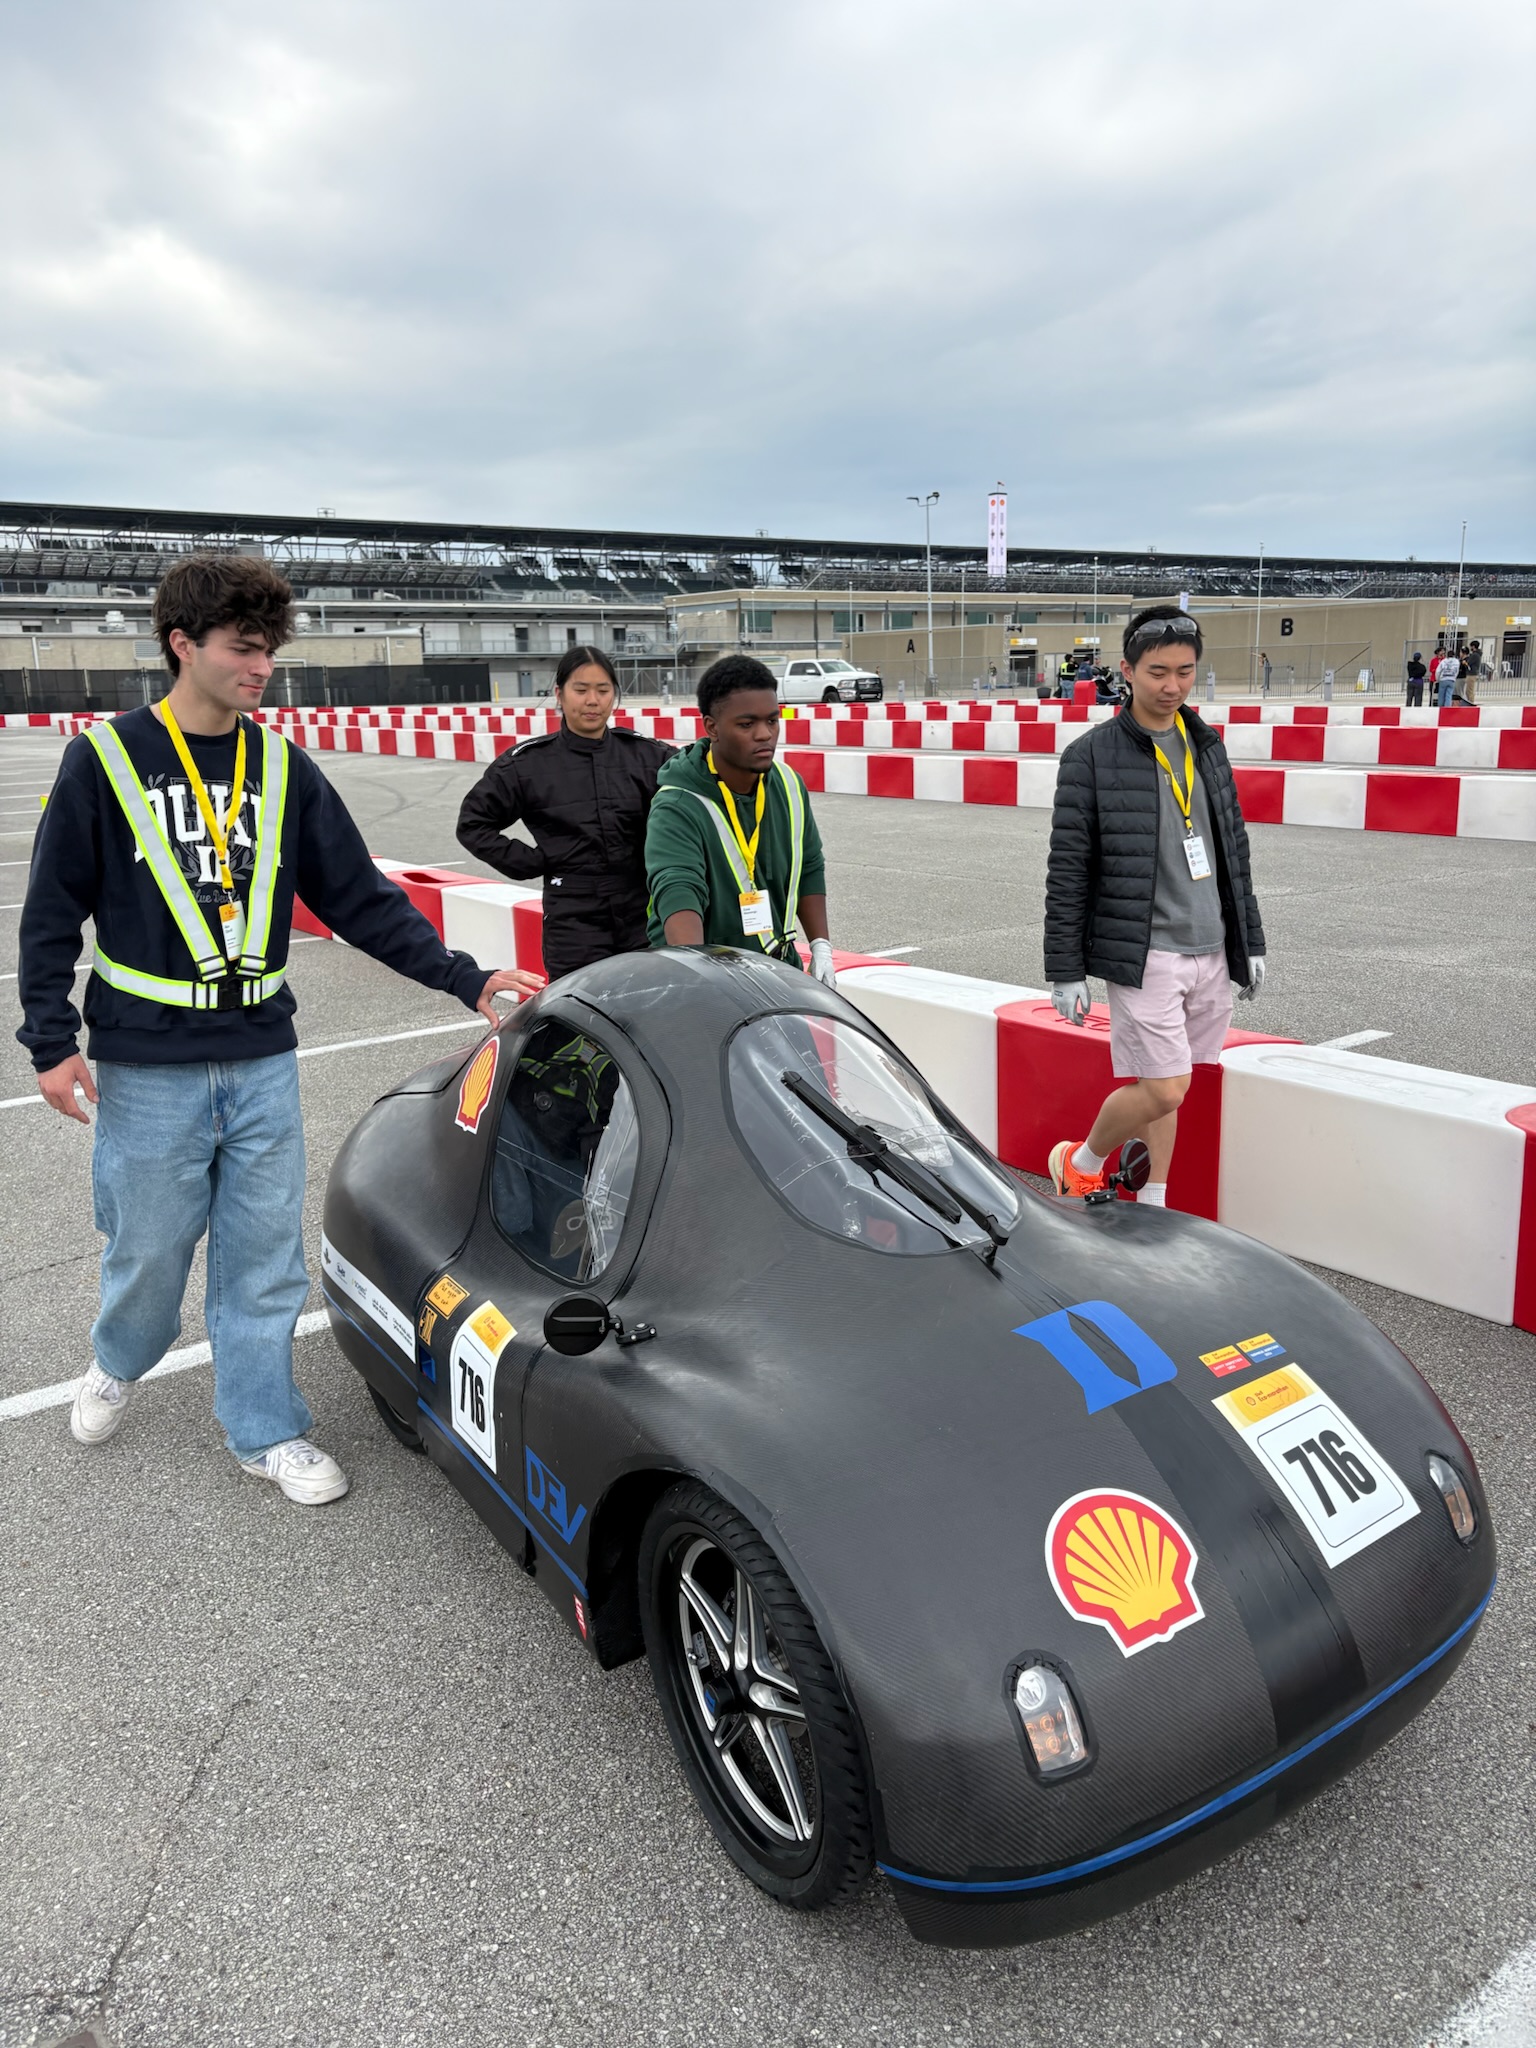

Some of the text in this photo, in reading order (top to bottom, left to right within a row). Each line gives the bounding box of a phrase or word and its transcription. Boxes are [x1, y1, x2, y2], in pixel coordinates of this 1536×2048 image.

[906, 638, 915, 653] A
[1280, 617, 1294, 636] B
[458, 1356, 486, 1433] 716
[525, 1444, 588, 1545] DEV
[1281, 1429, 1378, 1518] 716
